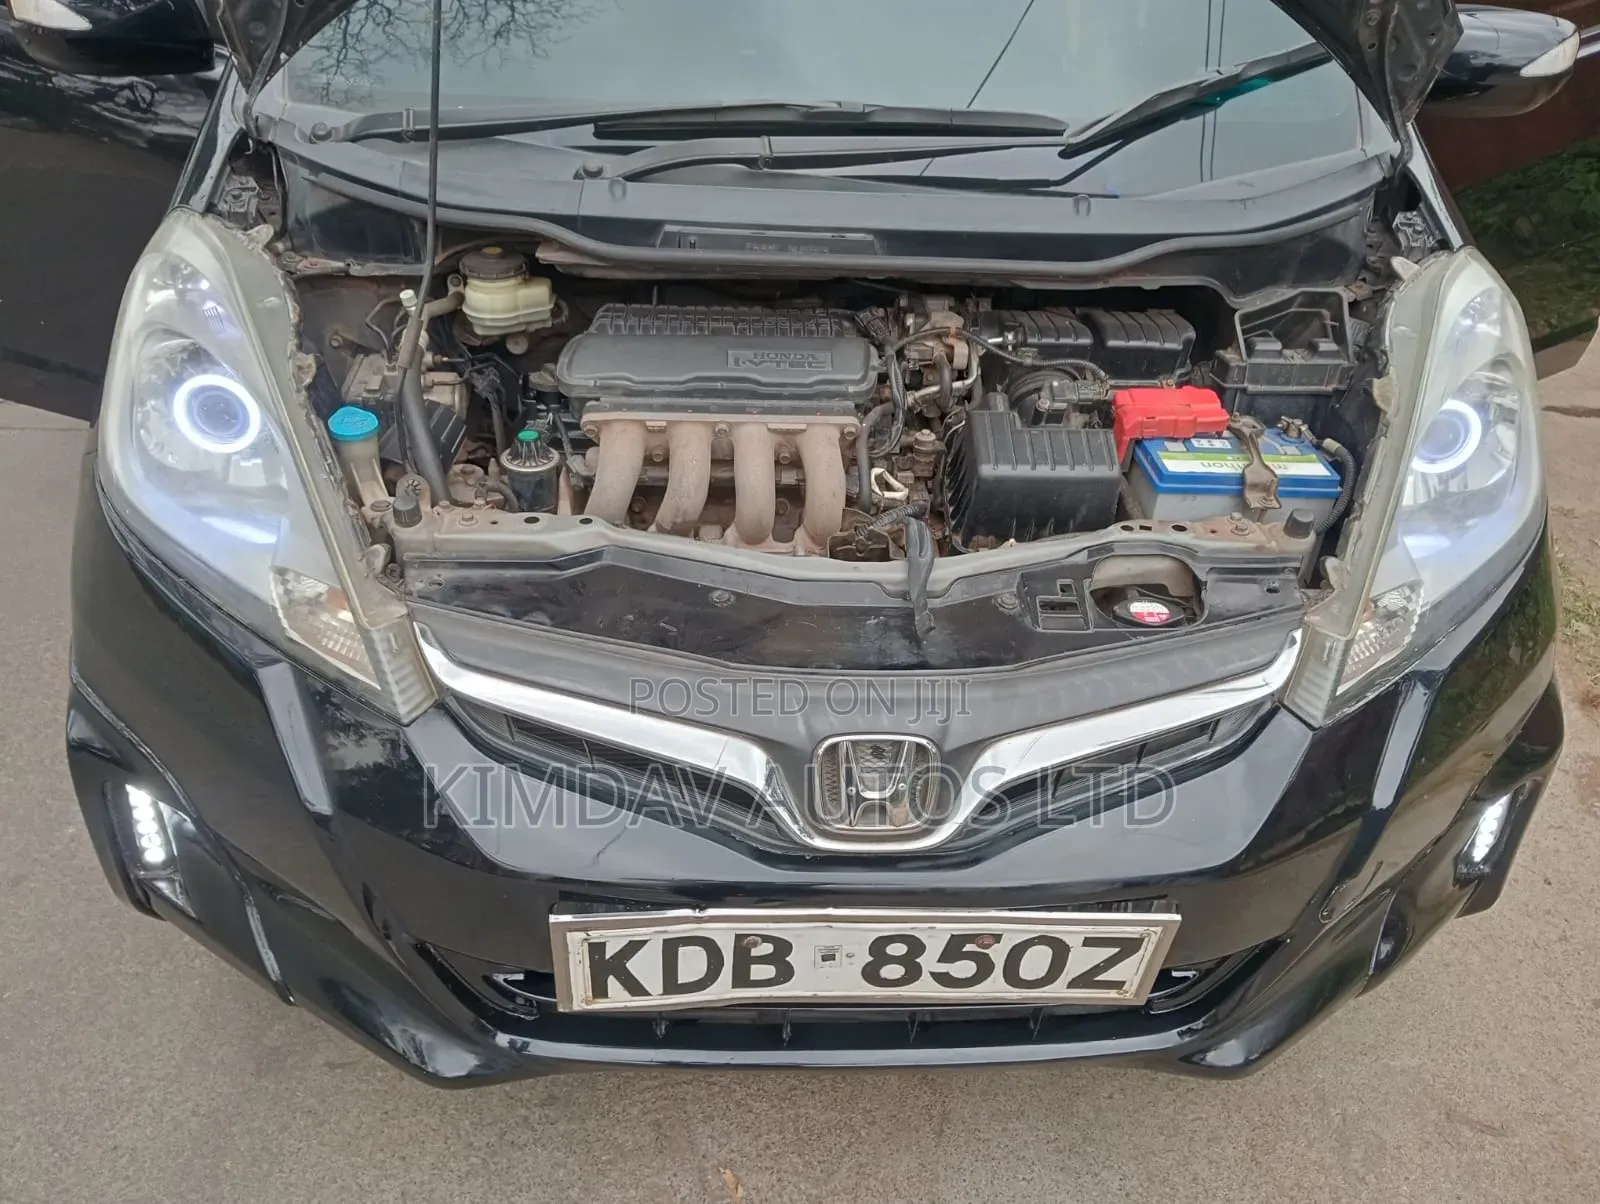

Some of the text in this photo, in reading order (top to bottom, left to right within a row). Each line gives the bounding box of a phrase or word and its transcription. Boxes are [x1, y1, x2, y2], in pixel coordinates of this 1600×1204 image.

[753, 352, 817, 360] HONDA
[587, 933, 1146, 999] KDB 850Z
